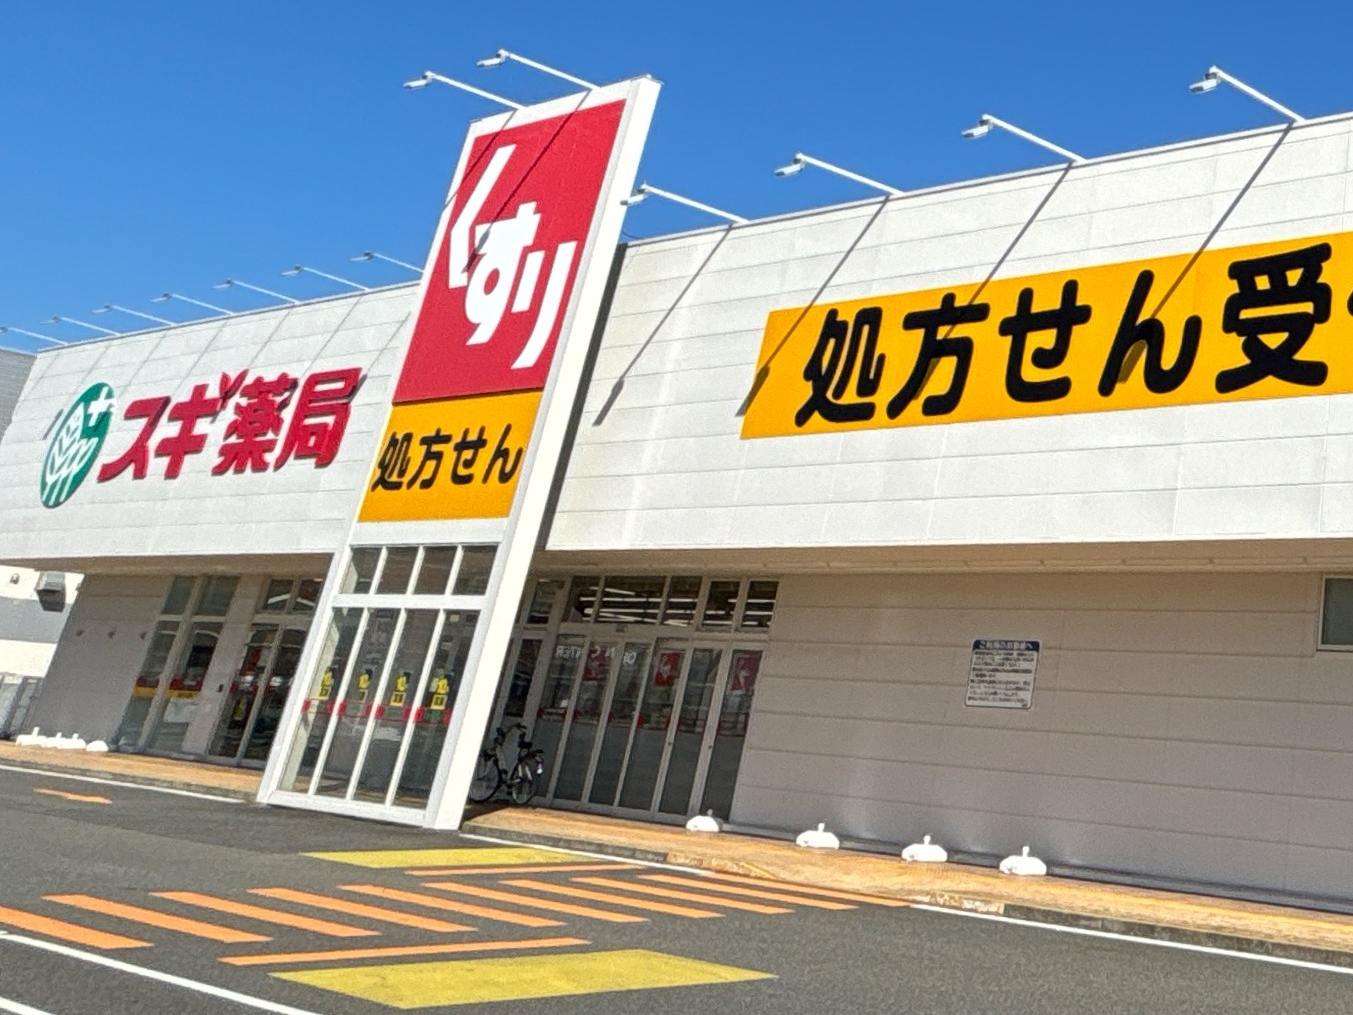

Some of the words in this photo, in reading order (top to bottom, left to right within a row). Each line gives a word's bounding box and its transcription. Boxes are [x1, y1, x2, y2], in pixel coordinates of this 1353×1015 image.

[448, 143, 579, 370] くすり
[97, 366, 363, 484] スギ薬局
[370, 422, 524, 493] 処方せん
